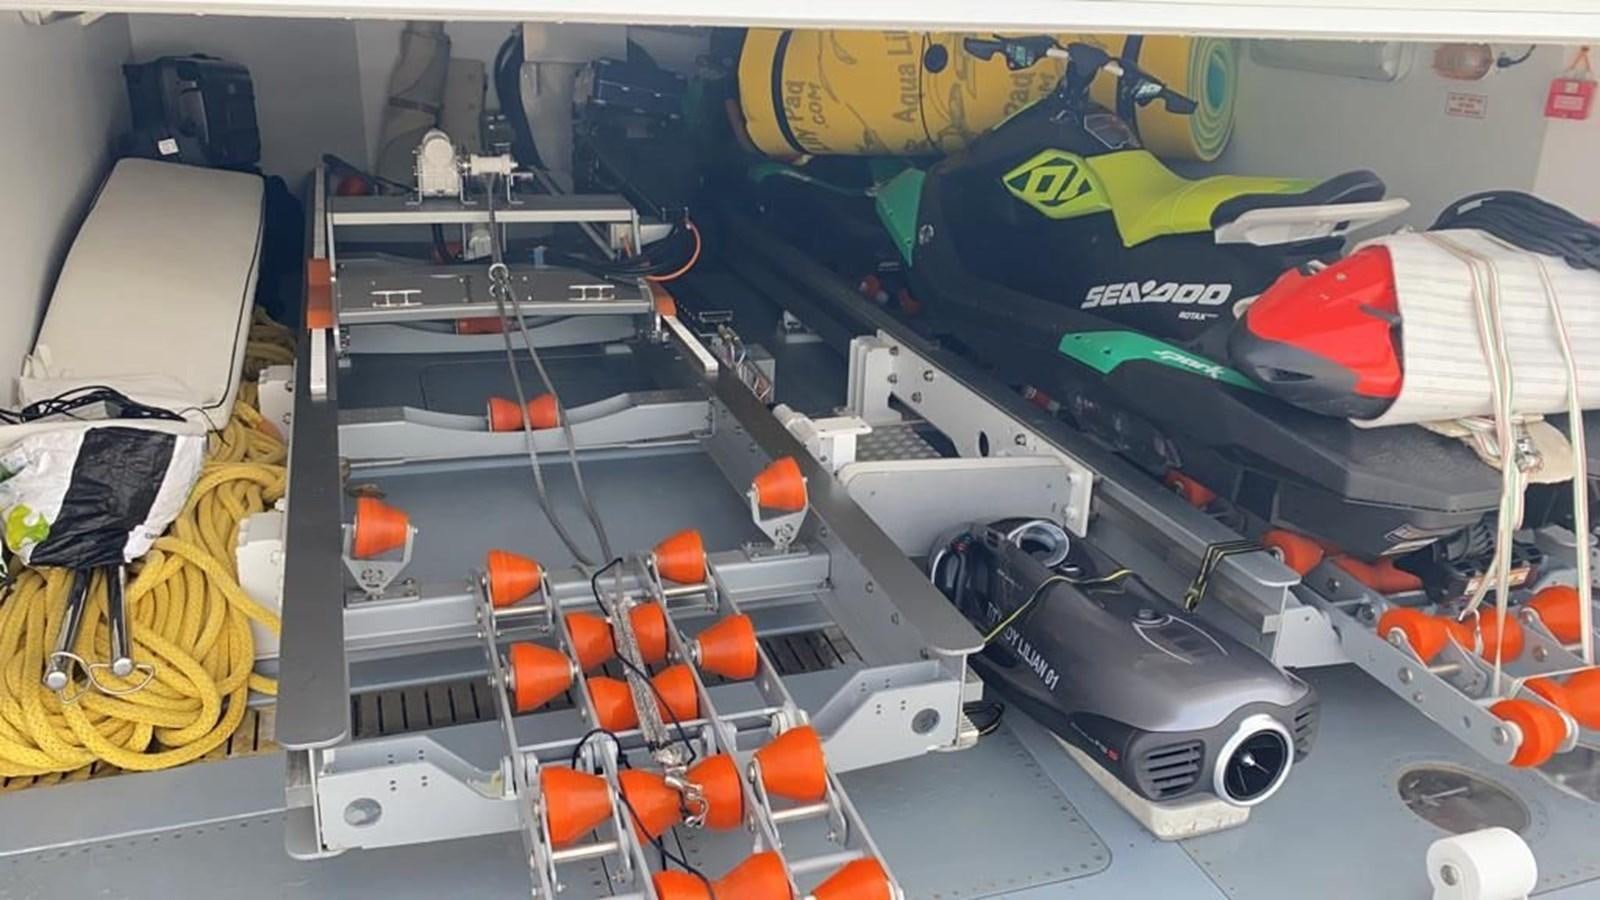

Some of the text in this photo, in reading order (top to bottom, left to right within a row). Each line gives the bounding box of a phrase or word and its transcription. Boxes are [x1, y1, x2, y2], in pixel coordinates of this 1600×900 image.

[891, 64, 920, 122] Aqua
[1017, 638, 1049, 678] LILIAN
[1044, 668, 1060, 691] 01
